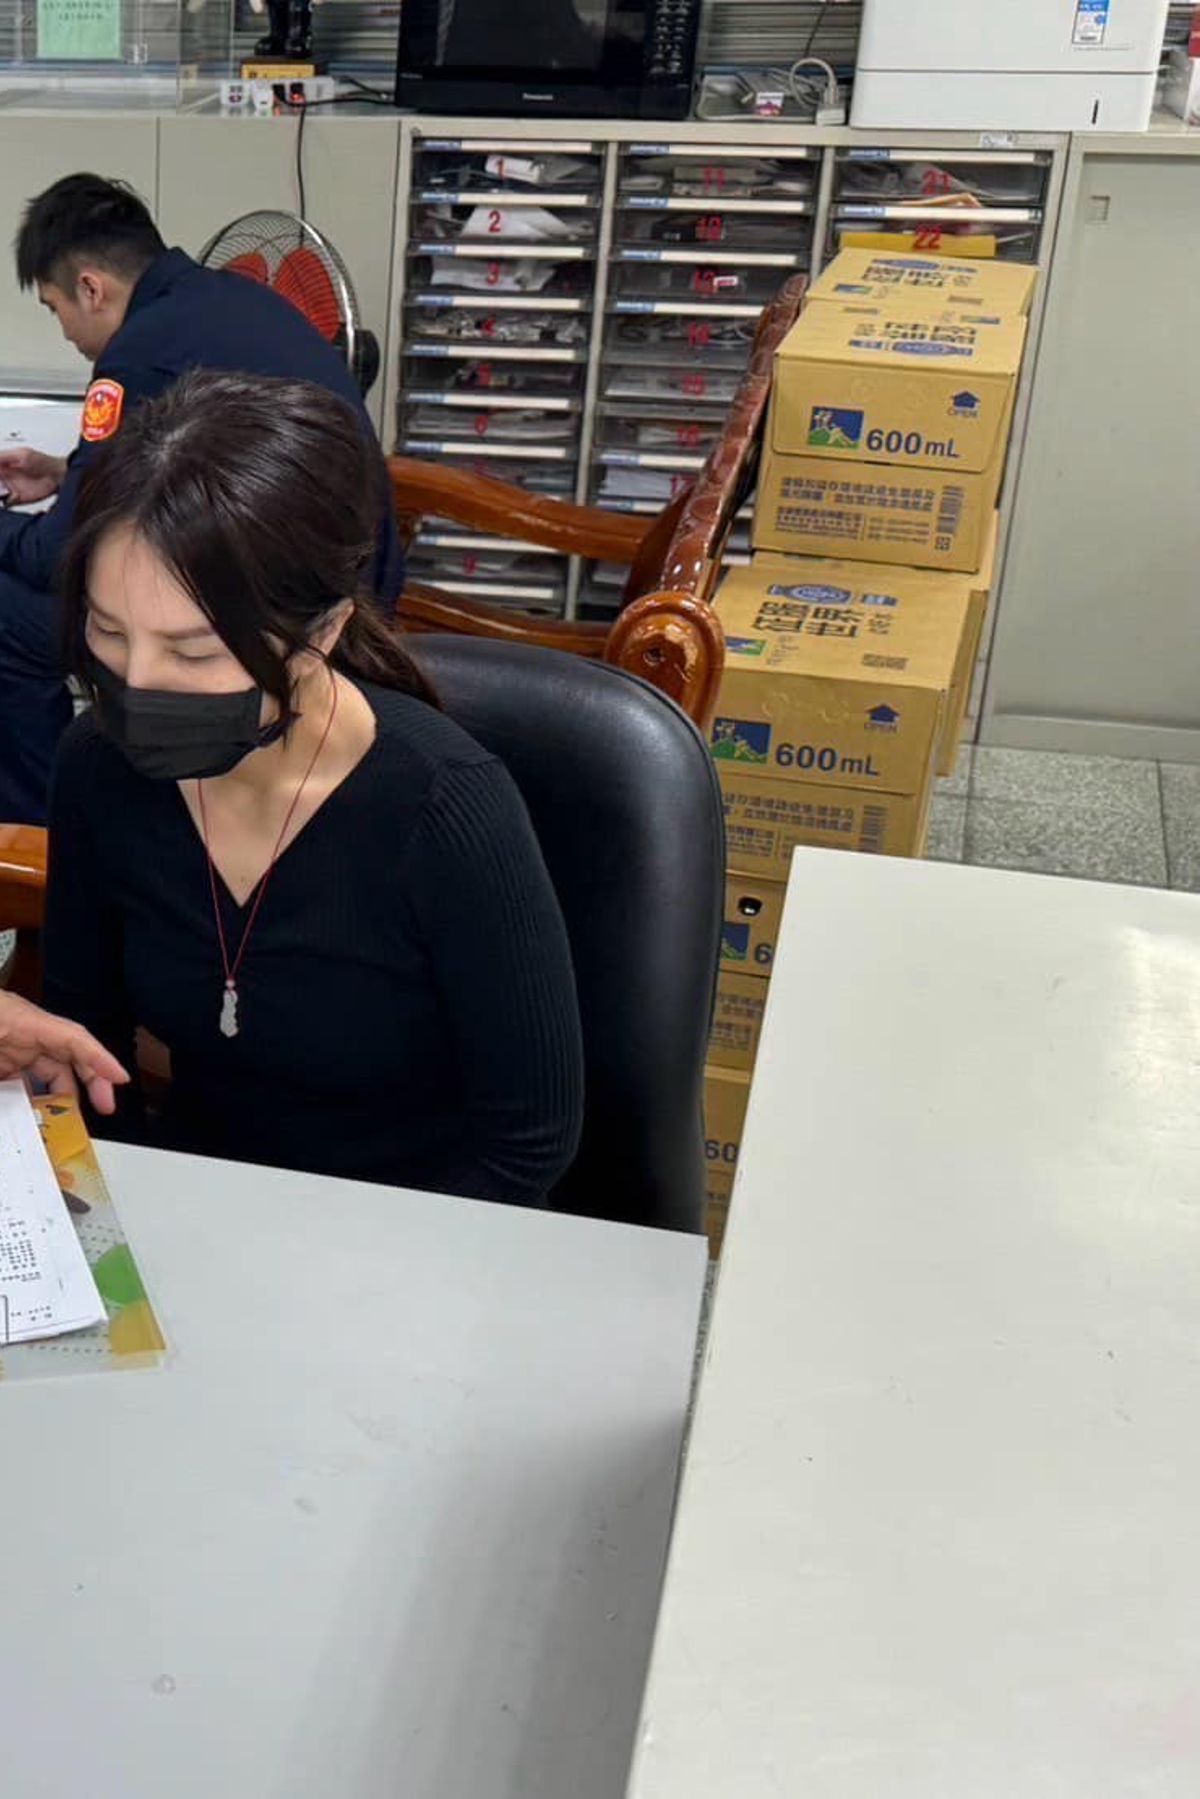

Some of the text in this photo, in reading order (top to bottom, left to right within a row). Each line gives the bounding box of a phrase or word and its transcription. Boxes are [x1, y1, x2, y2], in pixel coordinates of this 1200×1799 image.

[921, 169, 951, 195] 21
[488, 210, 502, 233] 2
[913, 225, 943, 250] 22
[486, 262, 500, 285] 3
